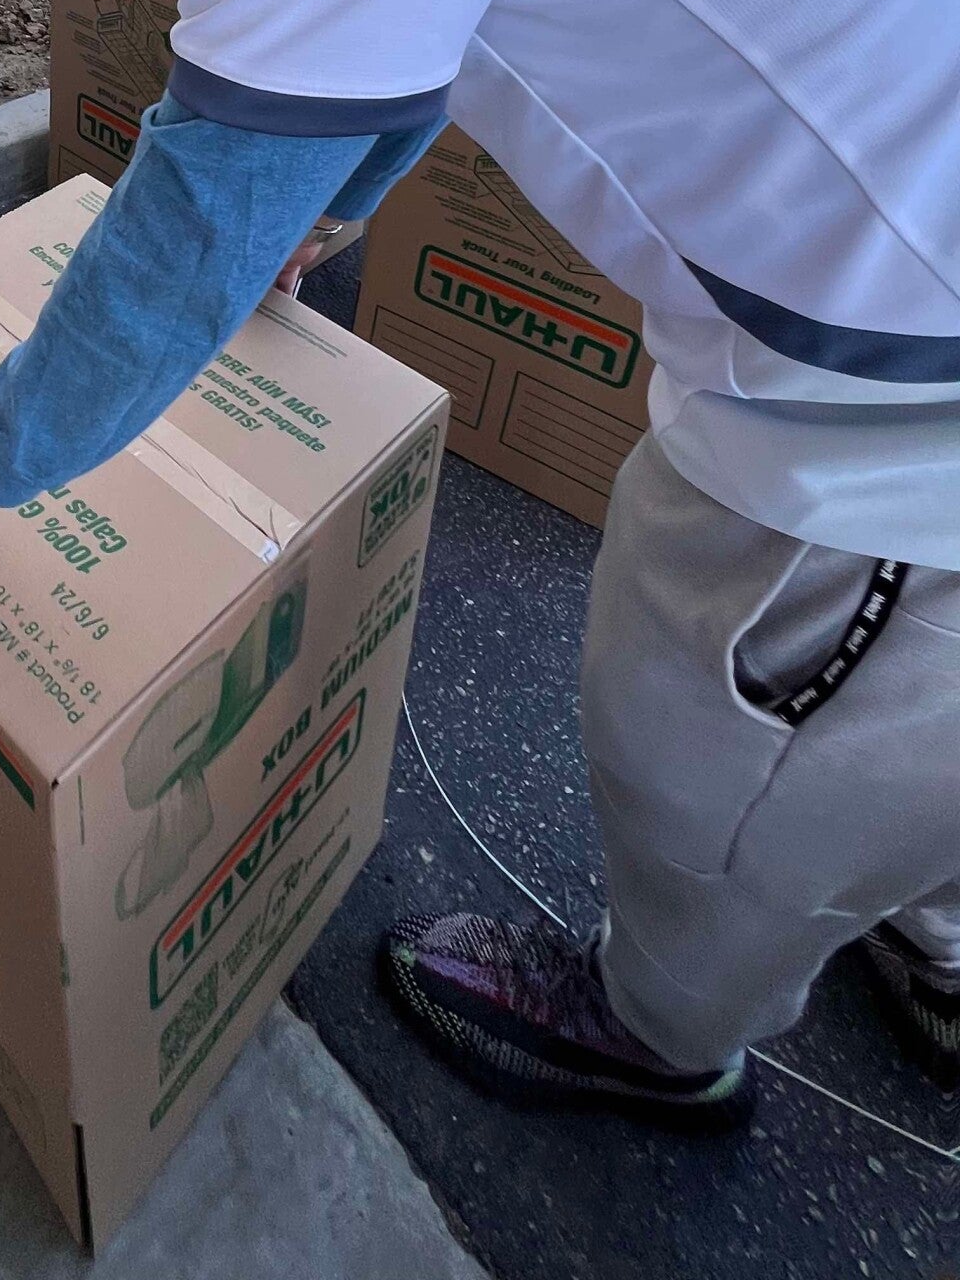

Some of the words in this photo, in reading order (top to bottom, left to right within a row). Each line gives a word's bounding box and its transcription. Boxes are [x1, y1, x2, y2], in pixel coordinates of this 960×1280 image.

[84, 113, 134, 155] AUL
[28, 243, 68, 272] Encue
[460, 238, 500, 263] Truck
[502, 256, 535, 278] Your
[540, 272, 601, 305] Loading
[431, 270, 617, 375] U-HAUL
[199, 386, 264, 435] GRATIS!
[200, 364, 262, 410] nuestro
[254, 401, 328, 456] paquete
[212, 349, 253, 379] RRE
[245, 368, 290, 401] AÚN
[280, 390, 334, 431] MÁS!
[34, 514, 103, 577] 100%
[59, 493, 132, 558] Cajas
[47, 579, 113, 643] 6/6/24
[23, 658, 87, 726] Product
[77, 678, 104, 706] 18
[262, 706, 311, 781] BOX
[167, 728, 350, 962] U-HAUL
